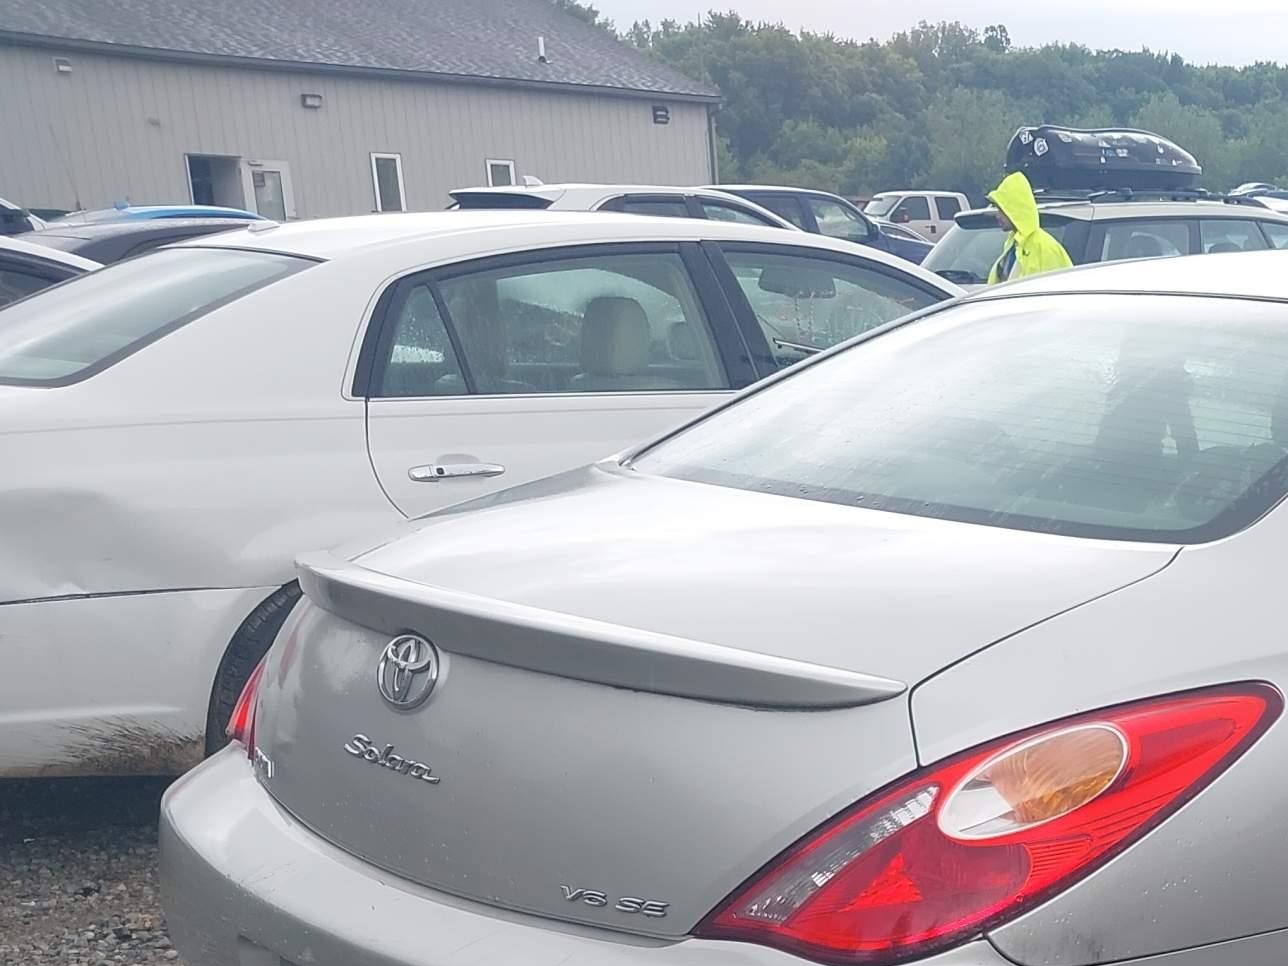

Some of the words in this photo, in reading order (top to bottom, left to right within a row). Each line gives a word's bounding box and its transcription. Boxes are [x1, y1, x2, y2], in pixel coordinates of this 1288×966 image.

[344, 733, 441, 785] Solara
[559, 884, 608, 907] V6
[615, 896, 670, 918] SE
